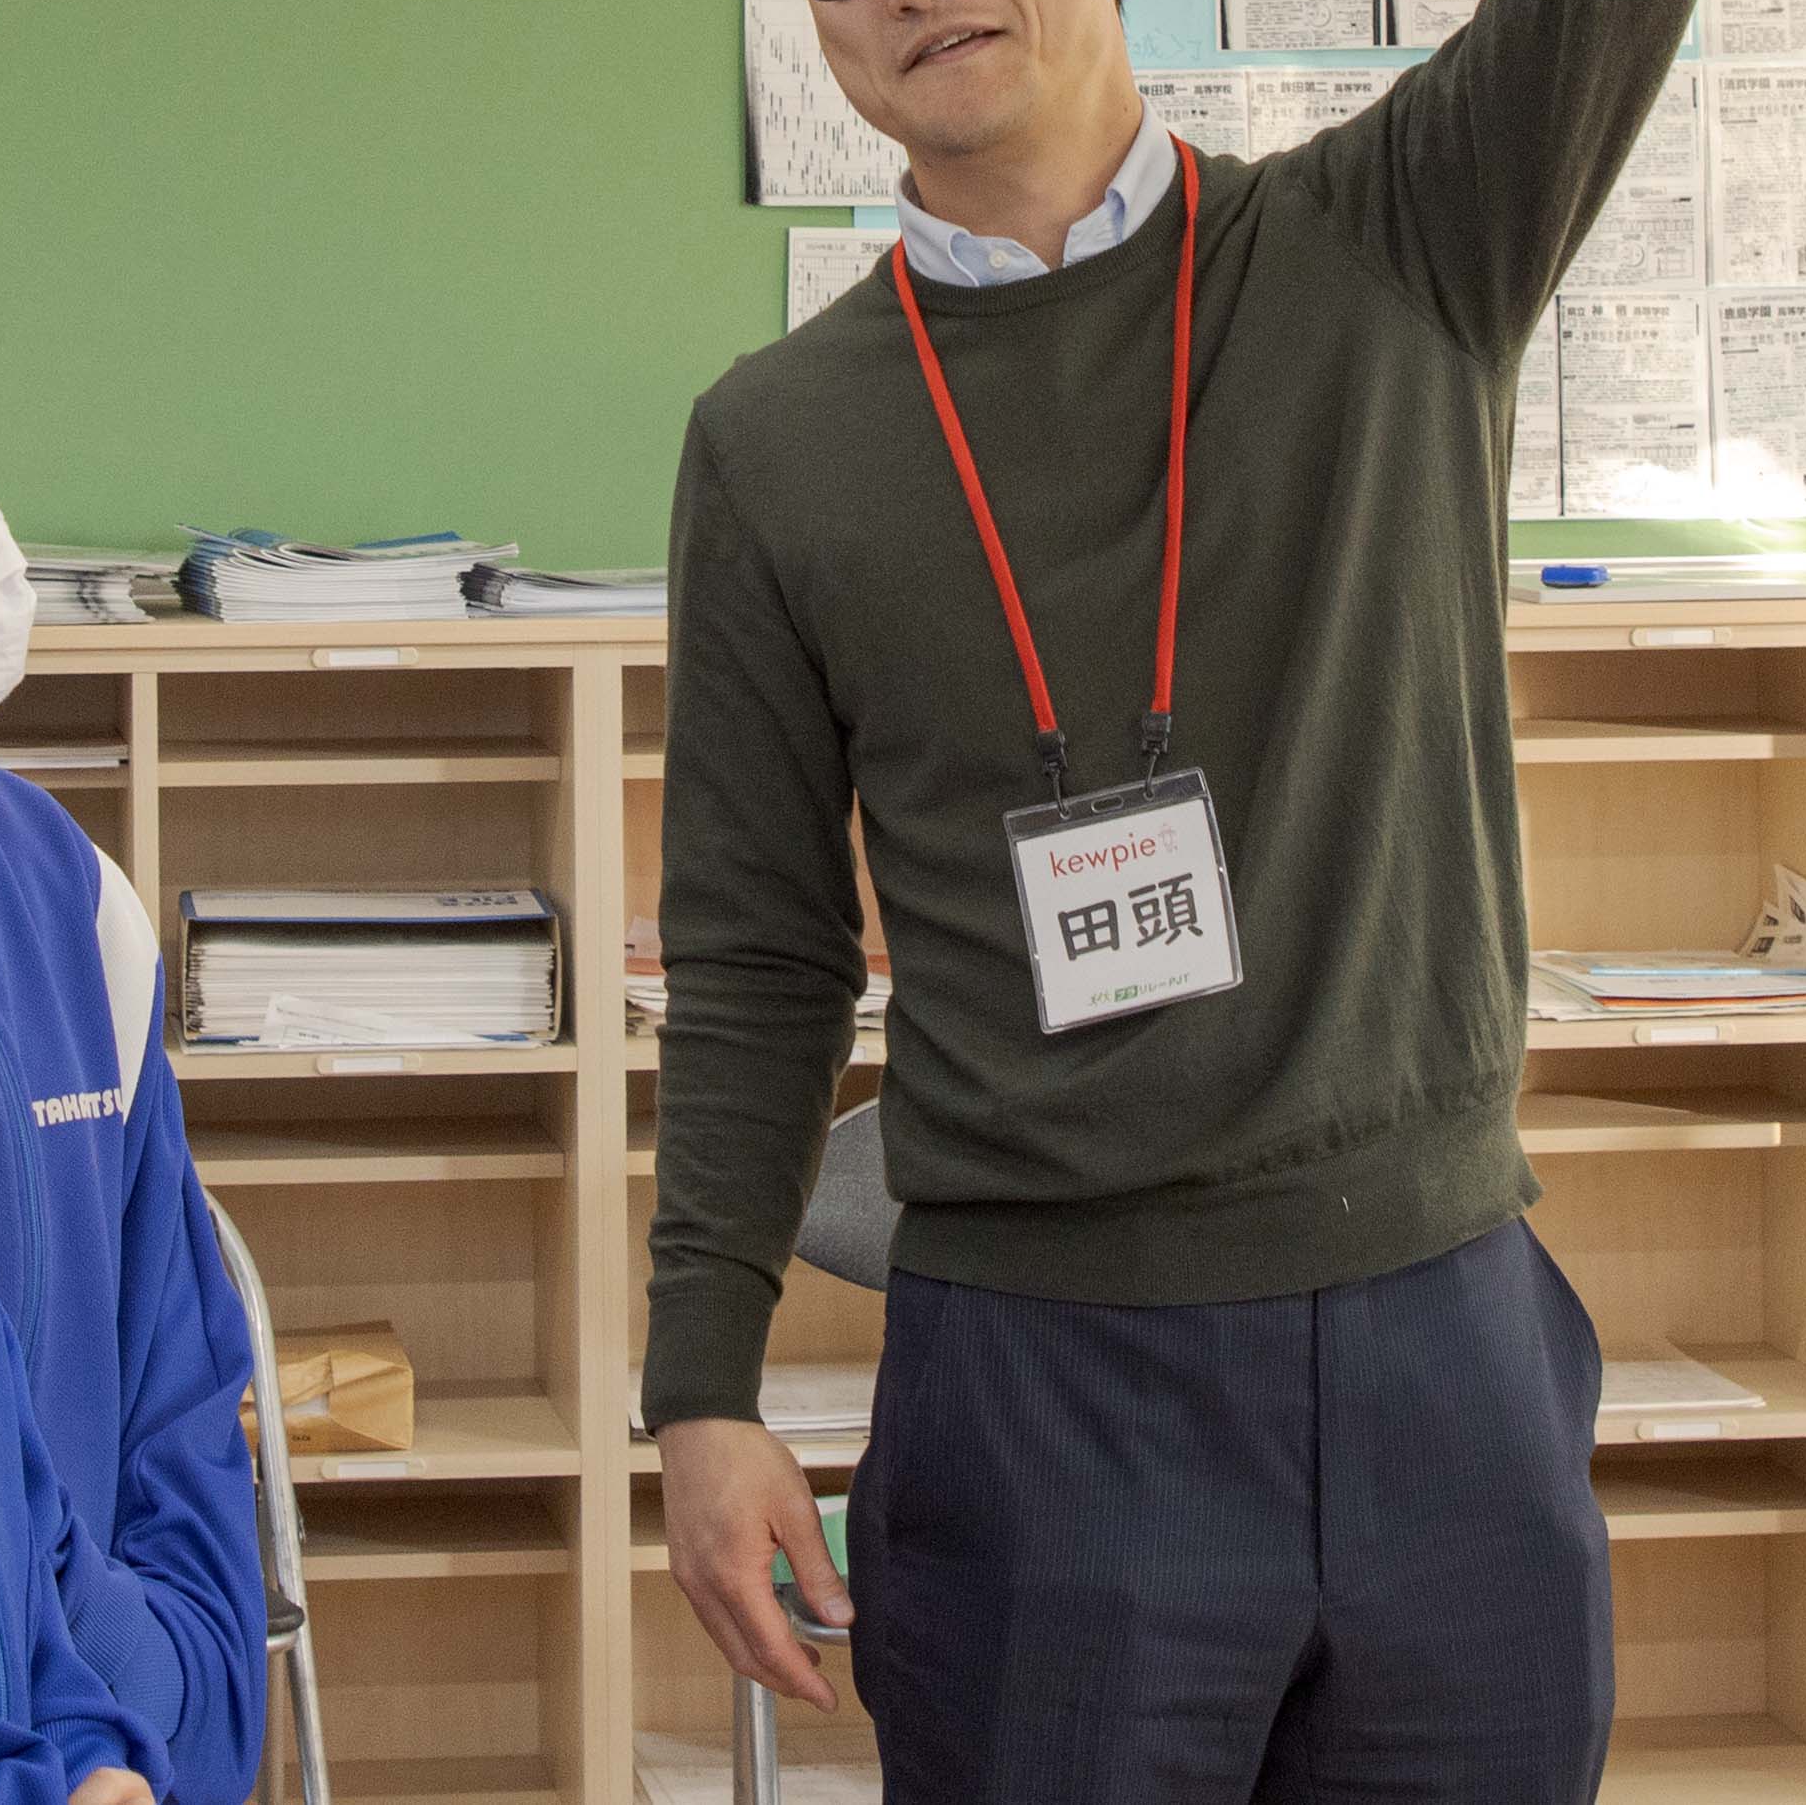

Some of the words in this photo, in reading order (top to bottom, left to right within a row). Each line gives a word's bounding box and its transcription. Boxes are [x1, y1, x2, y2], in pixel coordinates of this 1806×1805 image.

[1194, 83, 1233, 95] 高等学校
[1334, 83, 1372, 93] 高等学校
[1633, 306, 1670, 316] 高等学校
[1049, 832, 1156, 878] kewpie
[1057, 872, 1203, 961] 田頭
